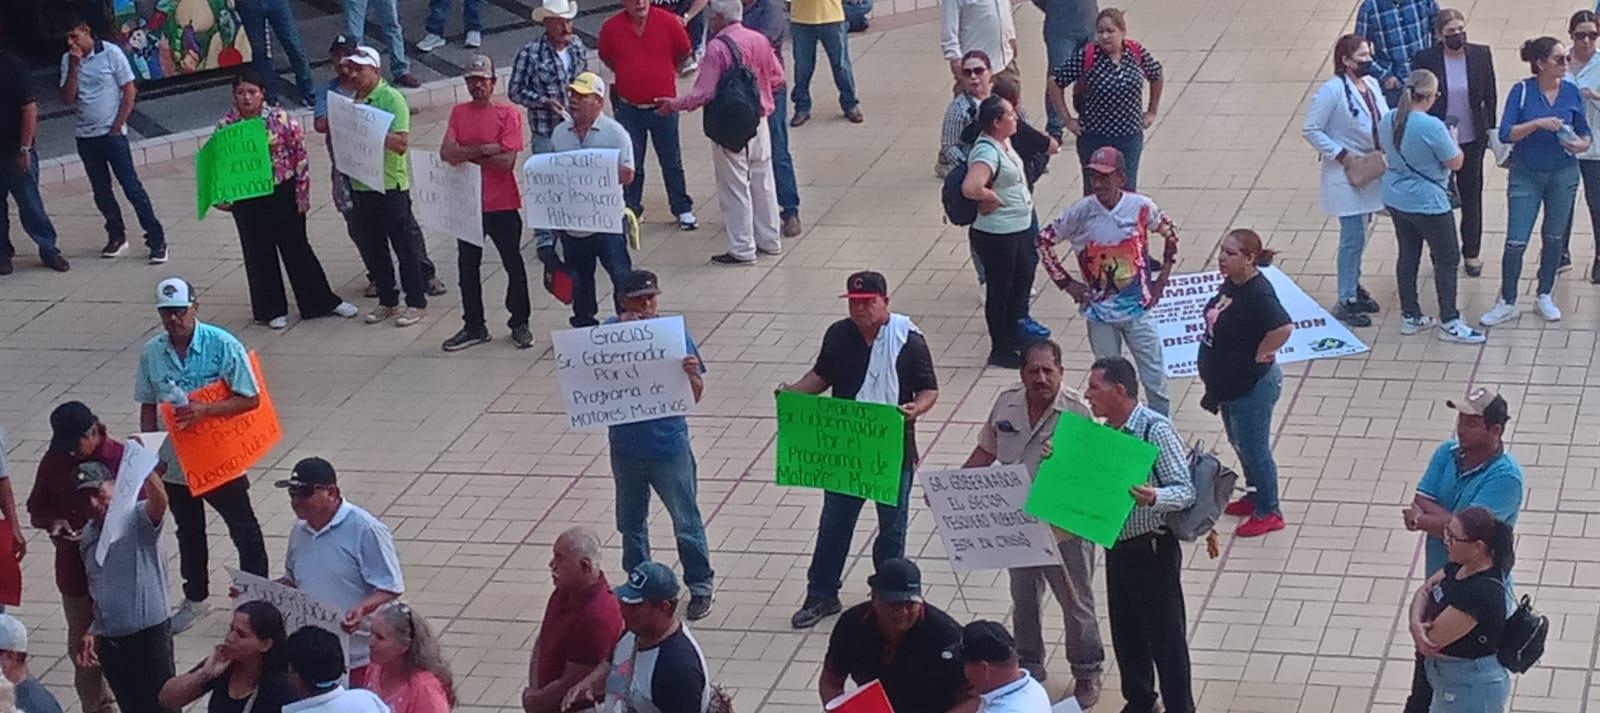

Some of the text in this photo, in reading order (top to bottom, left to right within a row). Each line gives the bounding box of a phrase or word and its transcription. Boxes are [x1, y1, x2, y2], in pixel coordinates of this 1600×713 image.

[589, 324, 655, 345] Gracias
[582, 343, 667, 366] Gobernador
[572, 386, 641, 405] Programa
[949, 471, 1023, 491] GOBERNADOR
